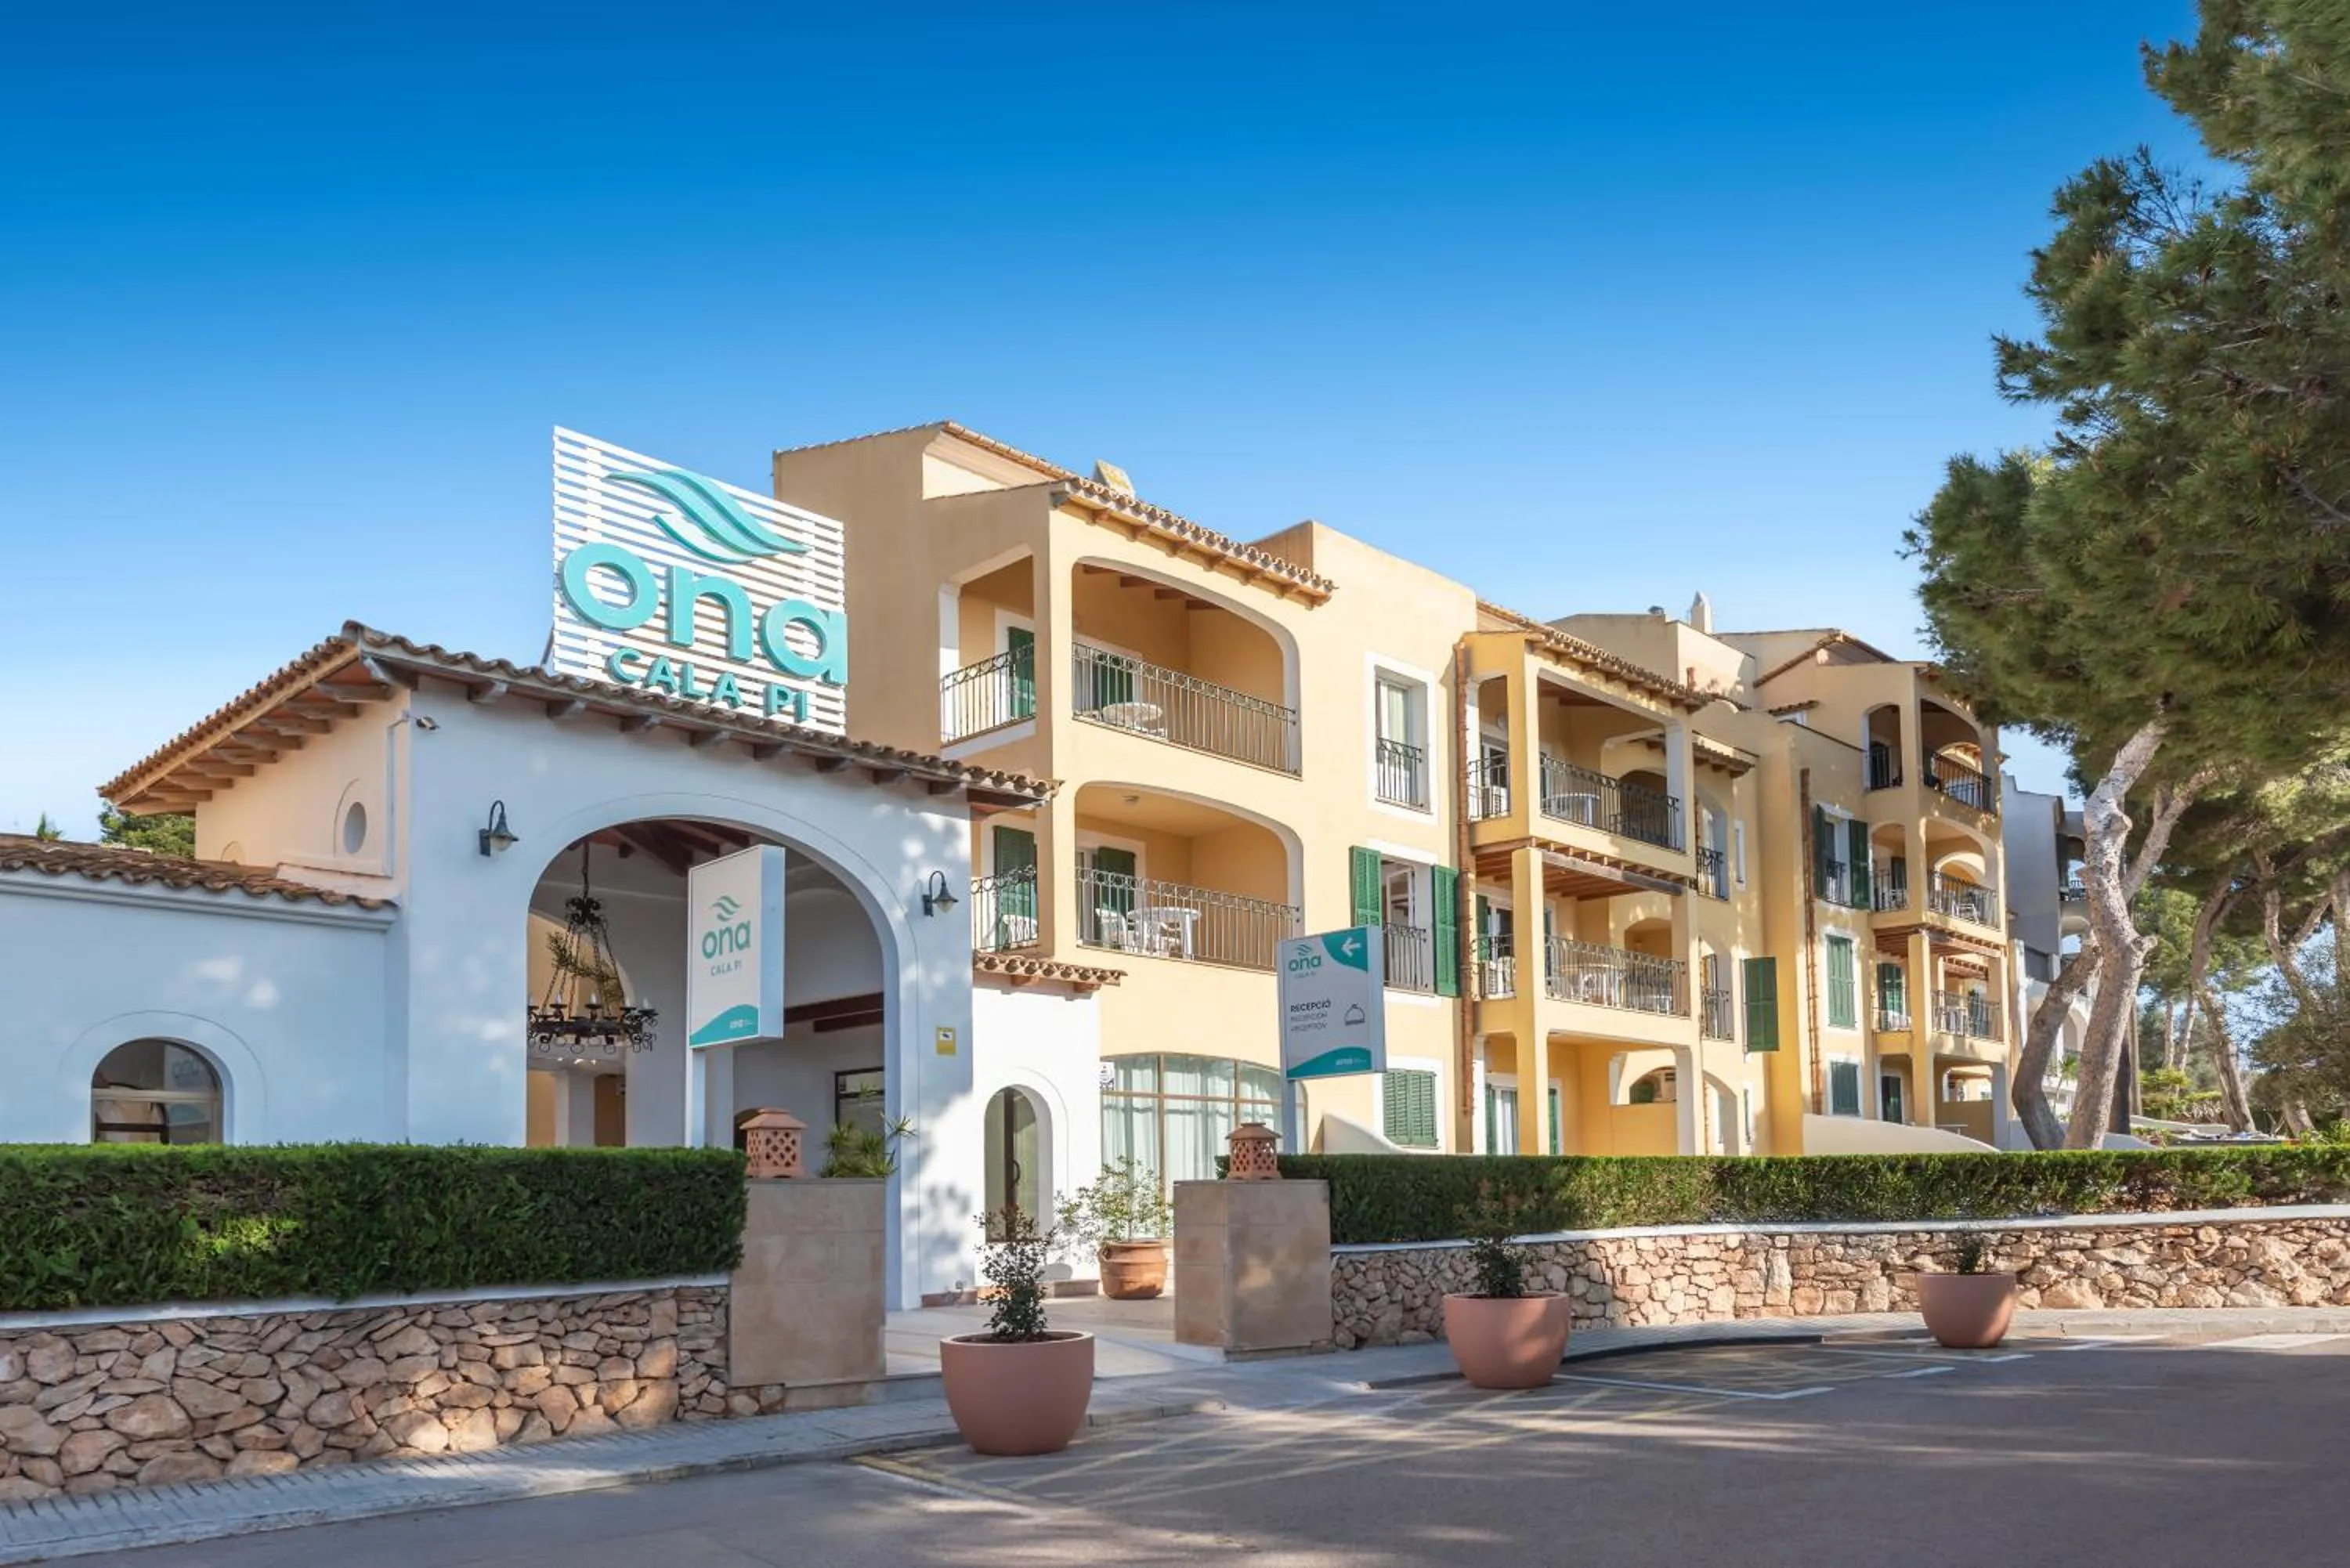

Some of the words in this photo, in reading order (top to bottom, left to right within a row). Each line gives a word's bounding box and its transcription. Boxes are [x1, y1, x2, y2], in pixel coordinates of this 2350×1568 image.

[560, 543, 848, 686] ona
[606, 648, 743, 710] CALA
[764, 682, 808, 723] PI
[702, 919, 751, 959] ona
[1289, 956, 1321, 971] ona
